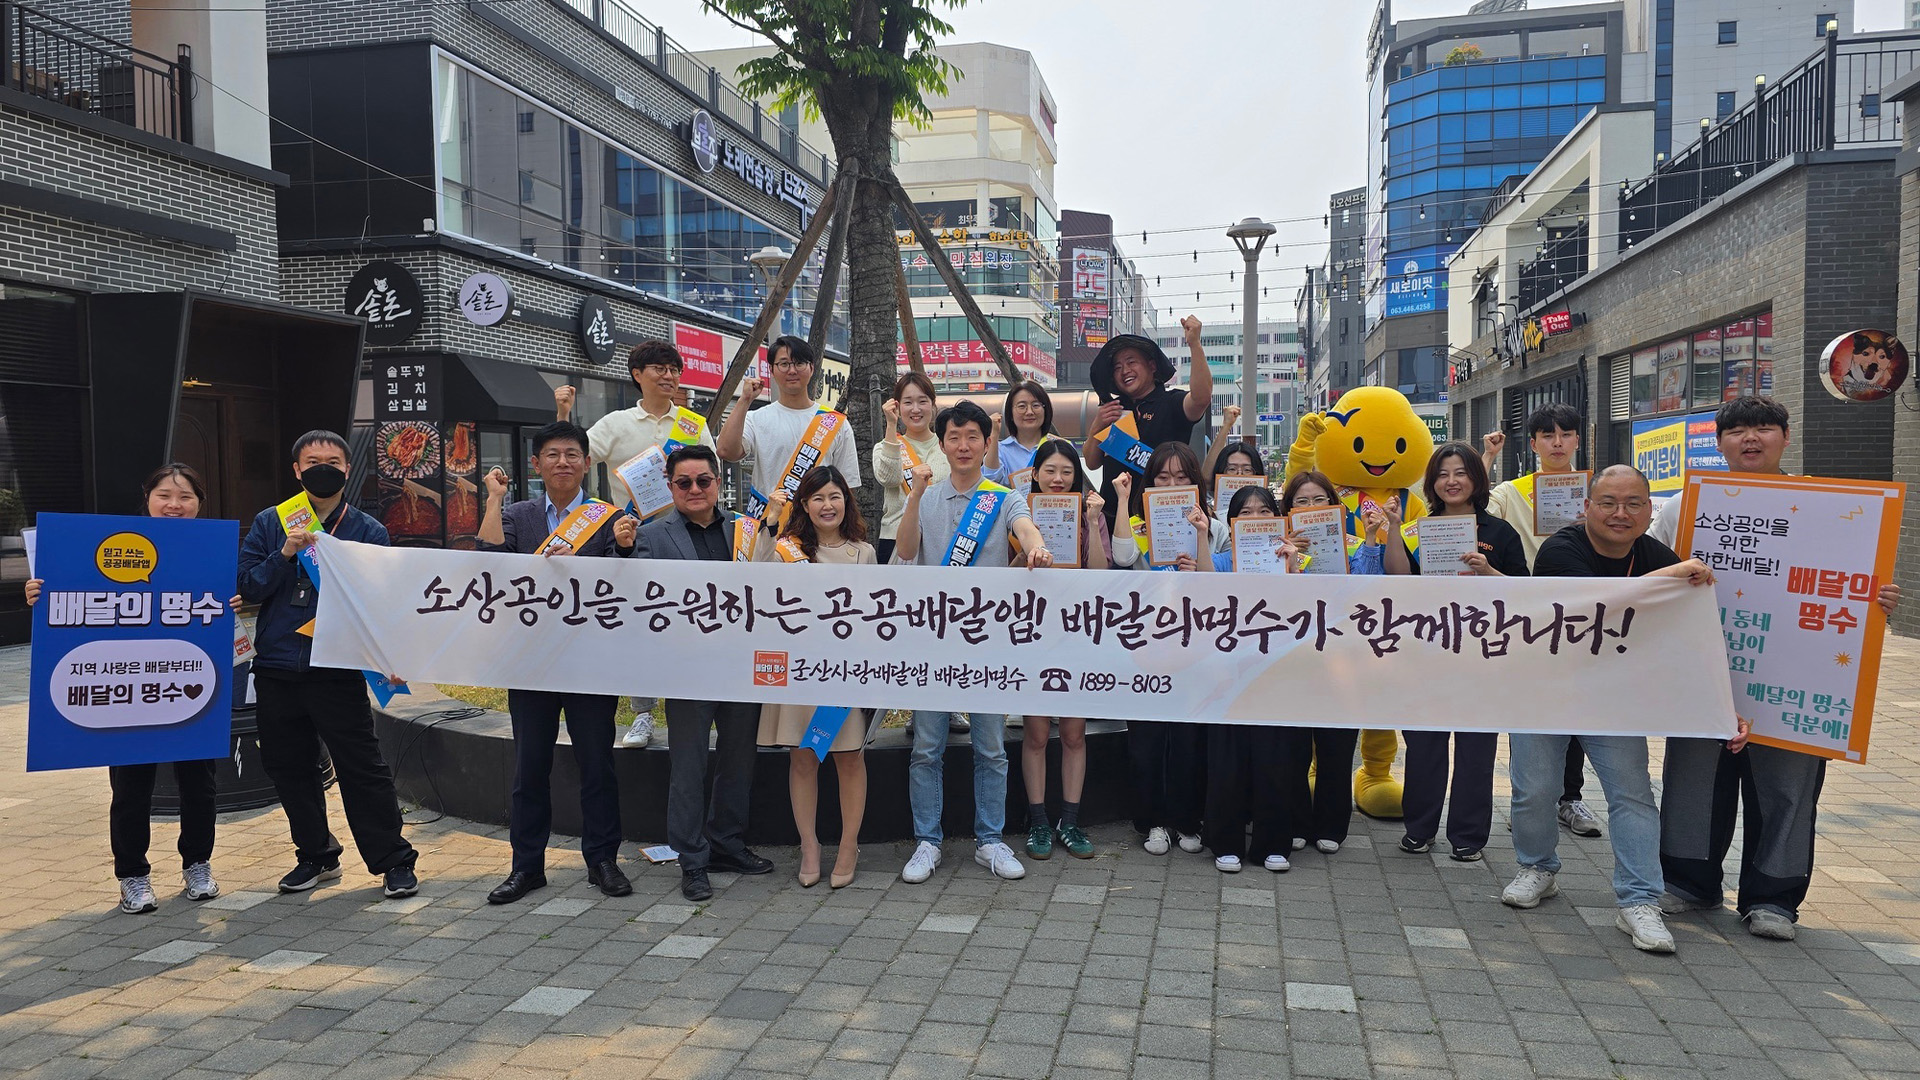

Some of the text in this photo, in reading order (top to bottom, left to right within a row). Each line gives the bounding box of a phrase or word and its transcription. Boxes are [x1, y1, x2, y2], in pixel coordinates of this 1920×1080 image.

[723, 140, 774, 195] 노래연습장
[938, 228, 968, 245] 수학
[989, 228, 1030, 249] 하이탑
[1076, 272, 1105, 293] PC
[1390, 275, 1433, 294] 새로이핏
[1547, 313, 1570, 323] Take
[1551, 322, 1569, 330] Out
[387, 382, 426, 395] 김치
[388, 399, 427, 412] 삼겹살
[811, 426, 829, 447] 배달앱
[792, 443, 821, 478] 배달의
[1638, 444, 1681, 481] 임대문의
[564, 516, 590, 541] 배달앱
[967, 512, 986, 538] 배달앱
[1694, 512, 1790, 537] 소상공인을
[103, 548, 145, 558] 믿고 쓰는
[1718, 535, 1760, 554] 위한
[103, 559, 150, 569] 공공배달앱
[1787, 566, 1879, 603] 배달의
[48, 591, 225, 627] 배달의 명수
[416, 571, 1636, 660] 소상공인을 응원하는 공공배달앱! 배달의명수가 함께합니다!
[1732, 608, 1772, 632] 동네
[1798, 602, 1858, 635] 명수
[1724, 630, 1765, 654] 님이
[70, 660, 203, 676] 지역 사랑은 배달부터!!
[791, 658, 929, 688] 군산사랑배달앱
[934, 663, 1029, 692] 배달의명수
[1727, 655, 1755, 674] 요!
[67, 682, 183, 707] 배달의 명수
[1747, 682, 1853, 717] 배달의 명수
[1781, 711, 1849, 740] 덕분에!
